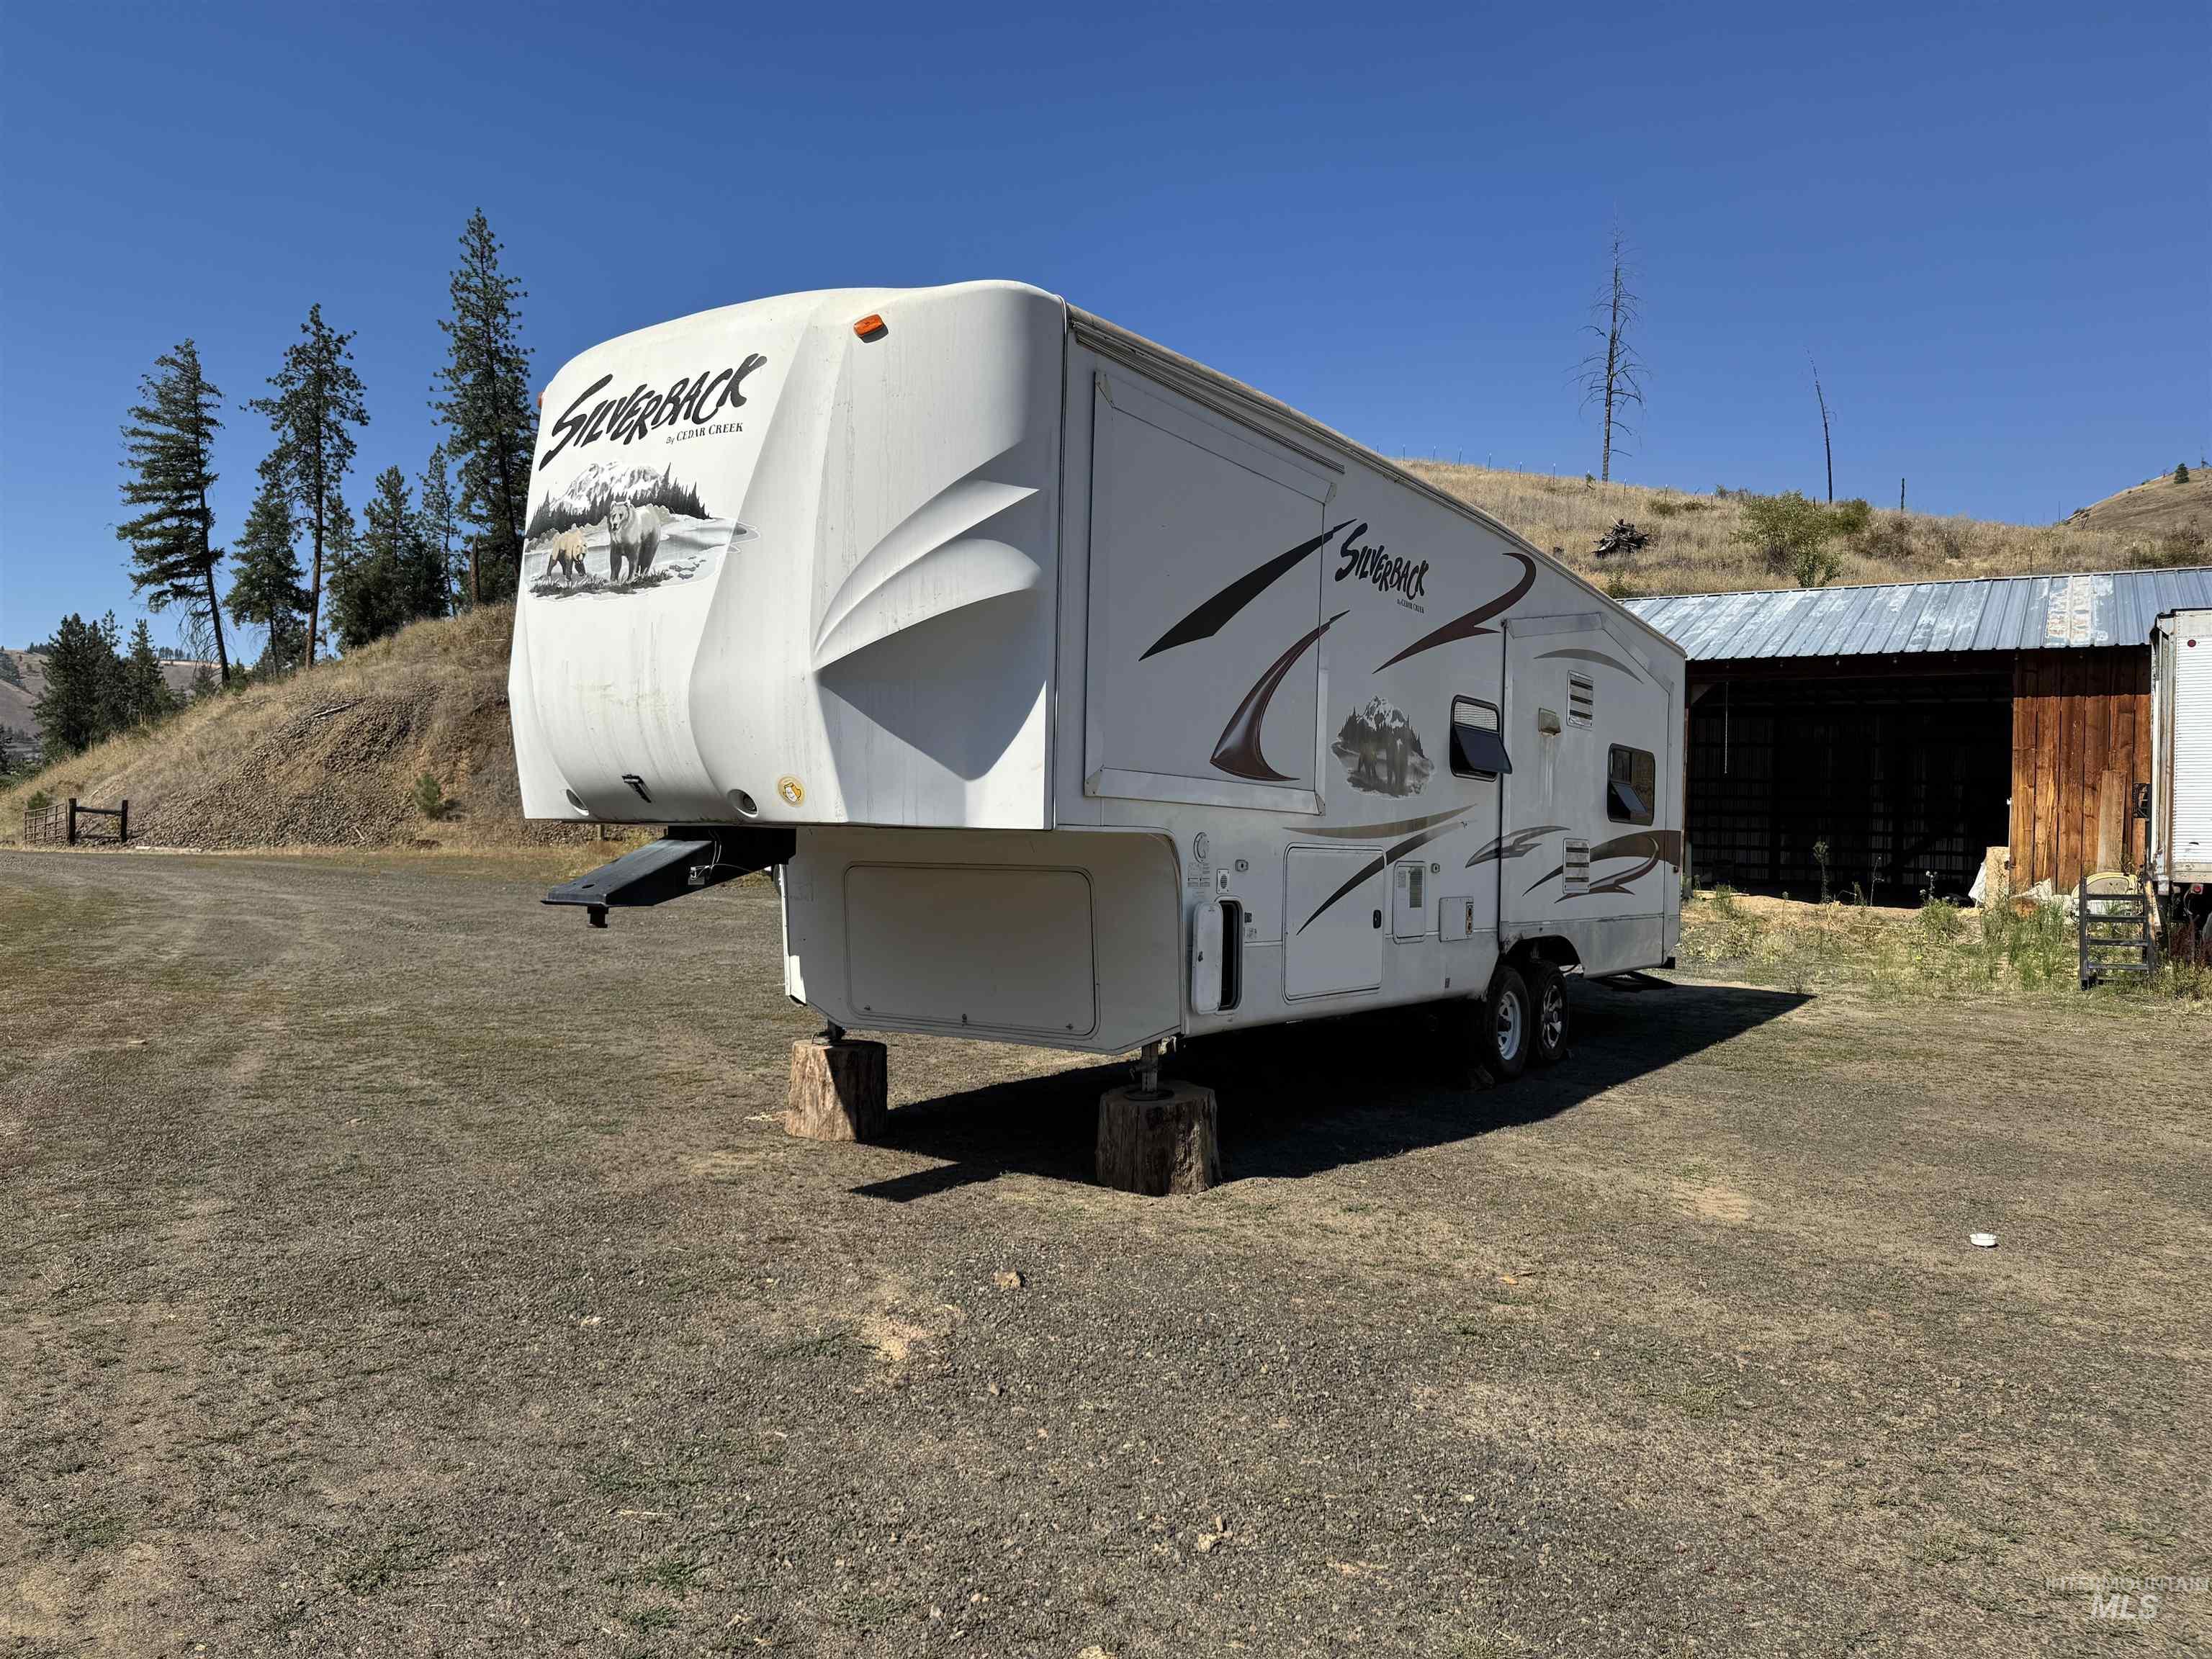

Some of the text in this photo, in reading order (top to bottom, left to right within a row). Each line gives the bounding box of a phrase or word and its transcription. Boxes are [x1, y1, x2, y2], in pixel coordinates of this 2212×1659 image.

[539, 353, 768, 471] SILVERBACK
[666, 422, 742, 445] By CEDAR CREEK
[1335, 522, 1429, 600] SILVERBACK
